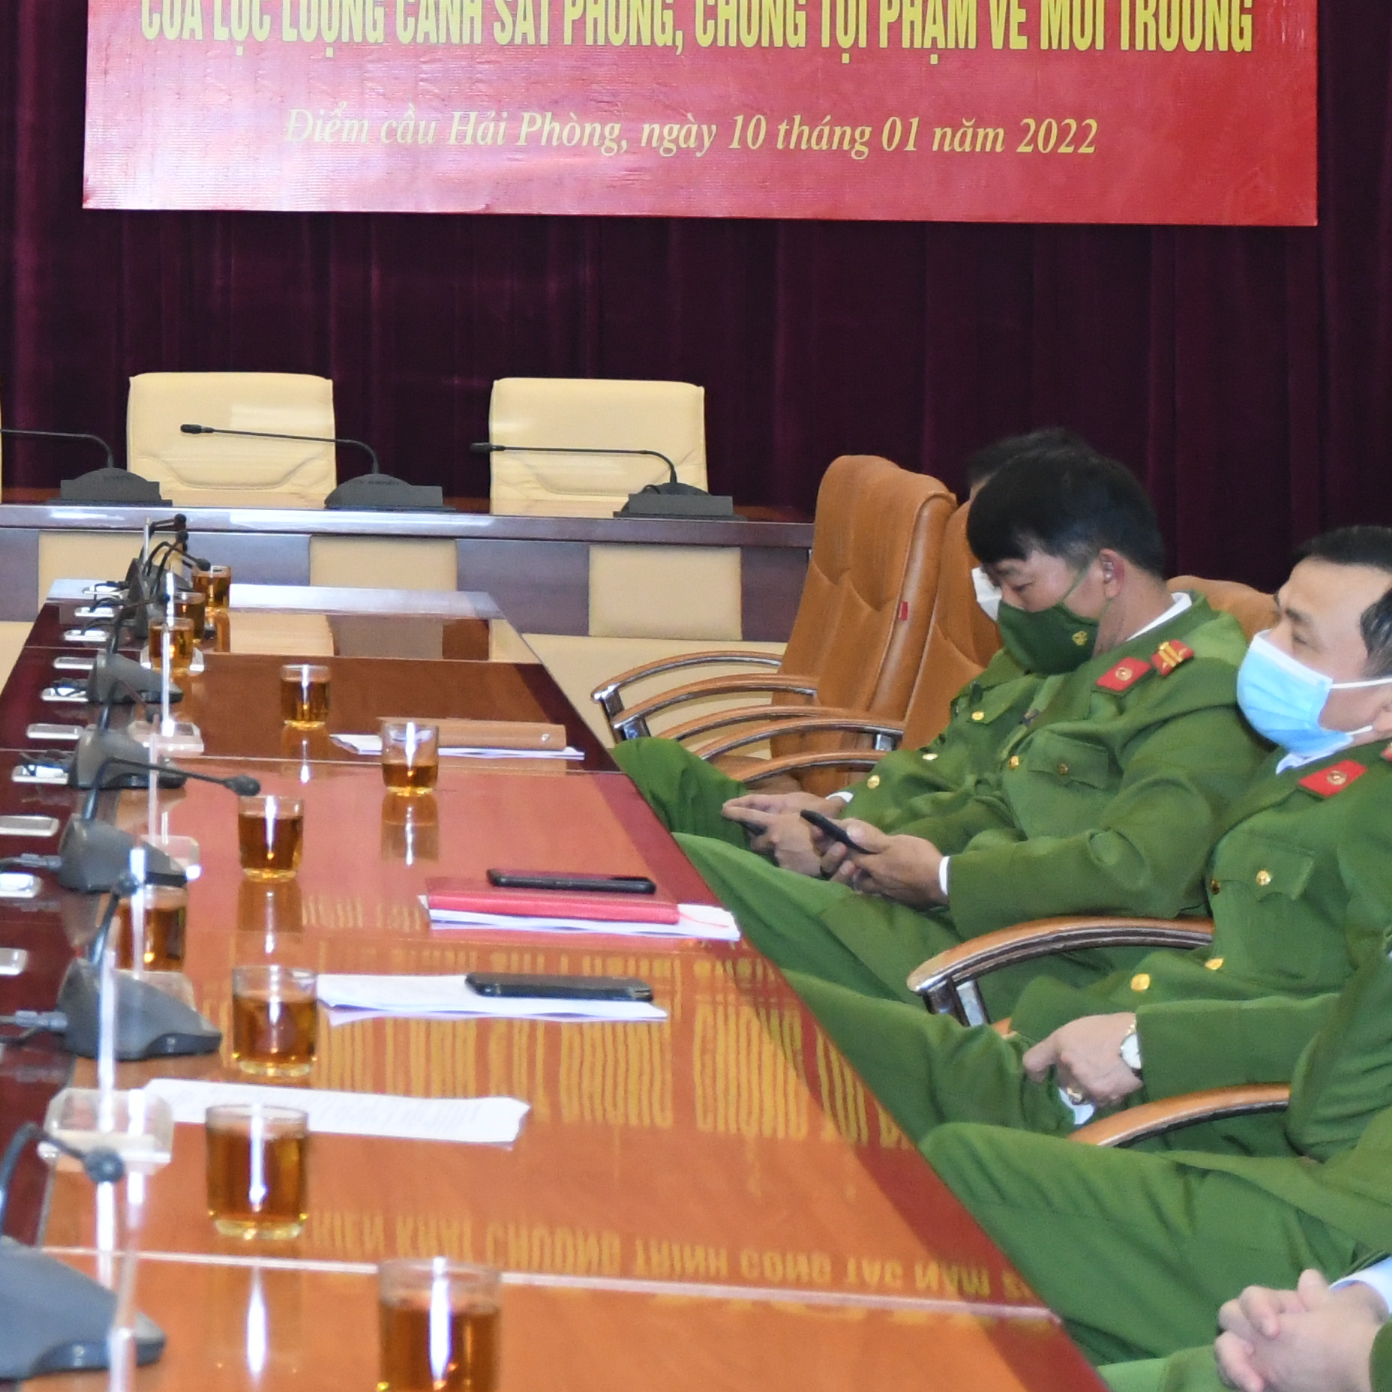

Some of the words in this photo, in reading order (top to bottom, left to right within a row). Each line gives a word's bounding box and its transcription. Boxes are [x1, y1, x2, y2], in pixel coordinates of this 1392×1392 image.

[284, 101, 370, 145] Điểm
[379, 103, 437, 144] cầu
[448, 111, 507, 145] Hải
[517, 112, 627, 156] Phòng,
[641, 113, 716, 157] ngày
[730, 115, 766, 149] 10
[777, 115, 872, 159] tháng
[882, 117, 919, 151] 01
[933, 119, 1004, 152] năm
[1017, 118, 1097, 153] 2022
